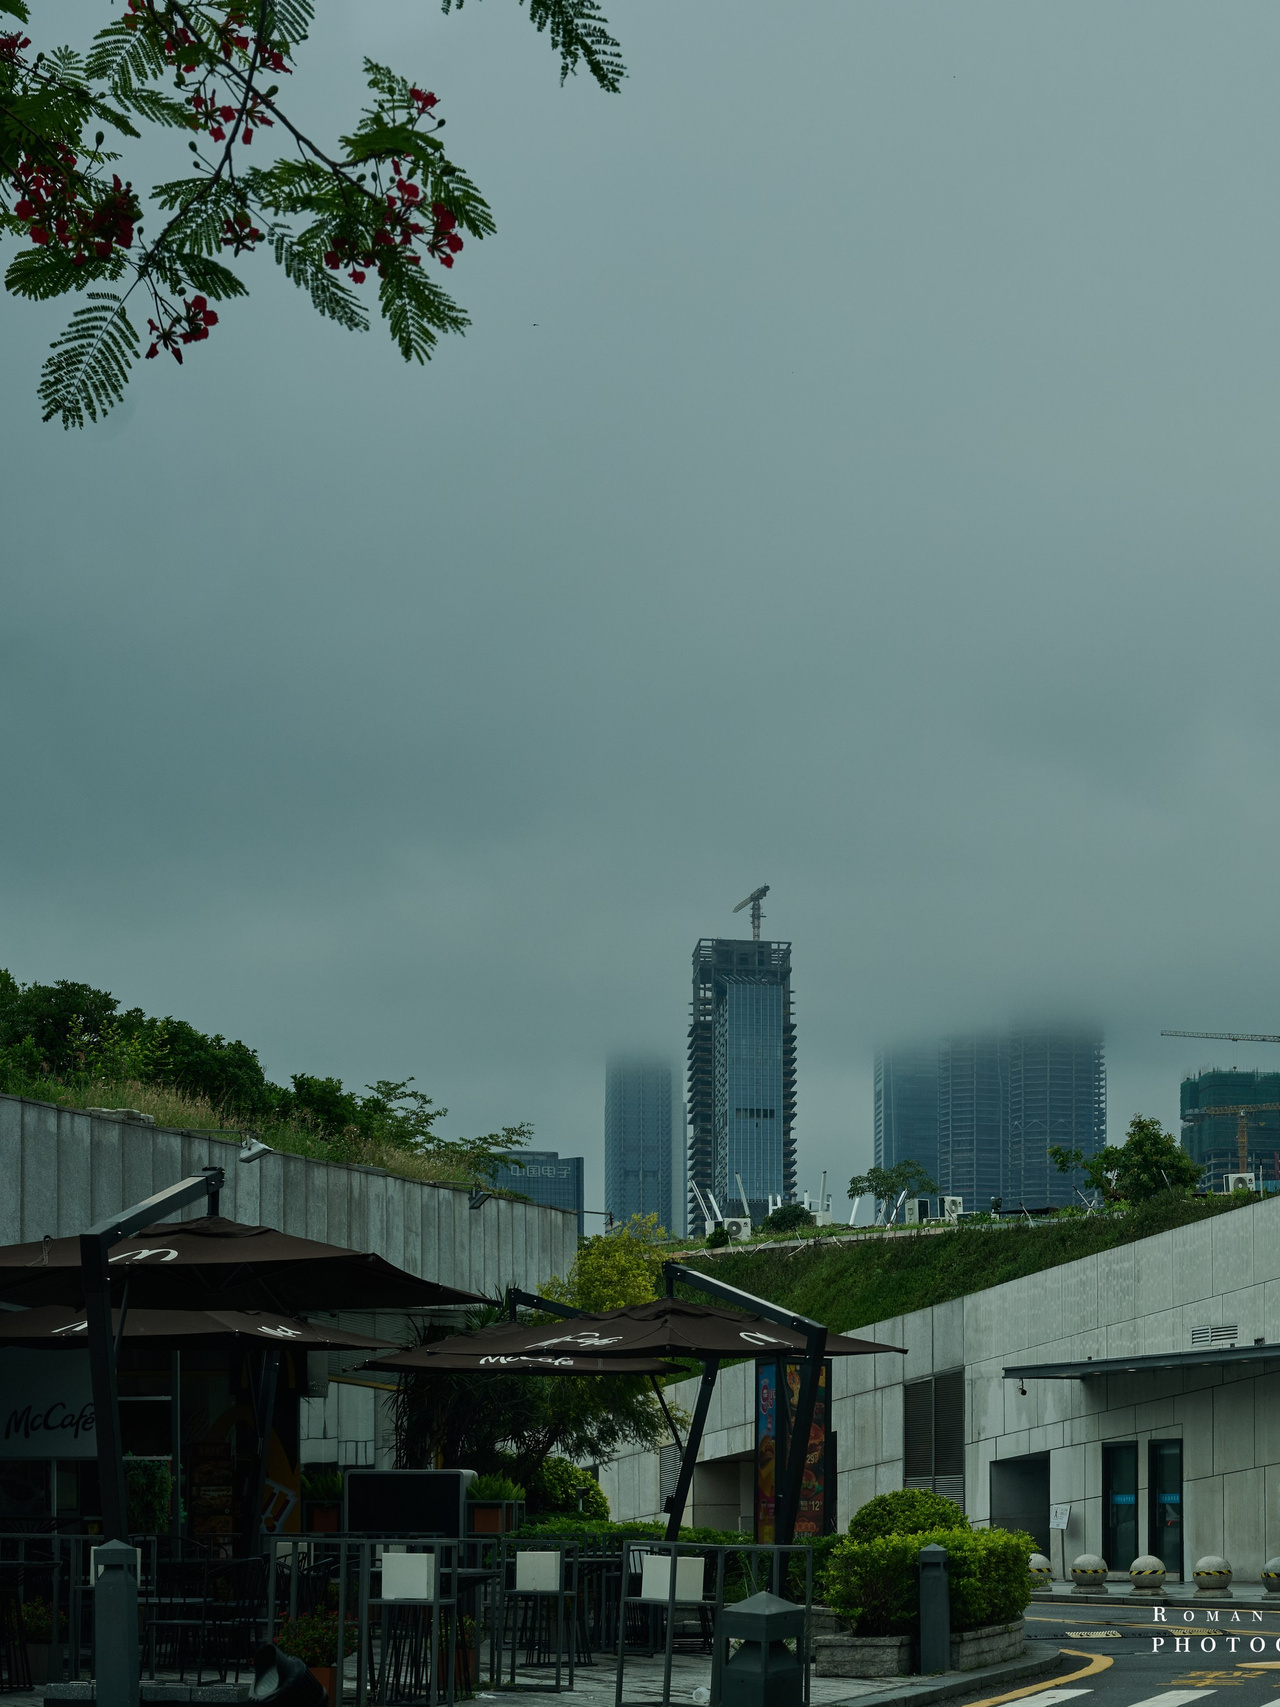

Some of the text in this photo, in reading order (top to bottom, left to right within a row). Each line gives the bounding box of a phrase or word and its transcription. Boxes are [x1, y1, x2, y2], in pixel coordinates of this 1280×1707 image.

[511, 1165, 571, 1178] 中国电子
[5, 1402, 95, 1440] McCafé
